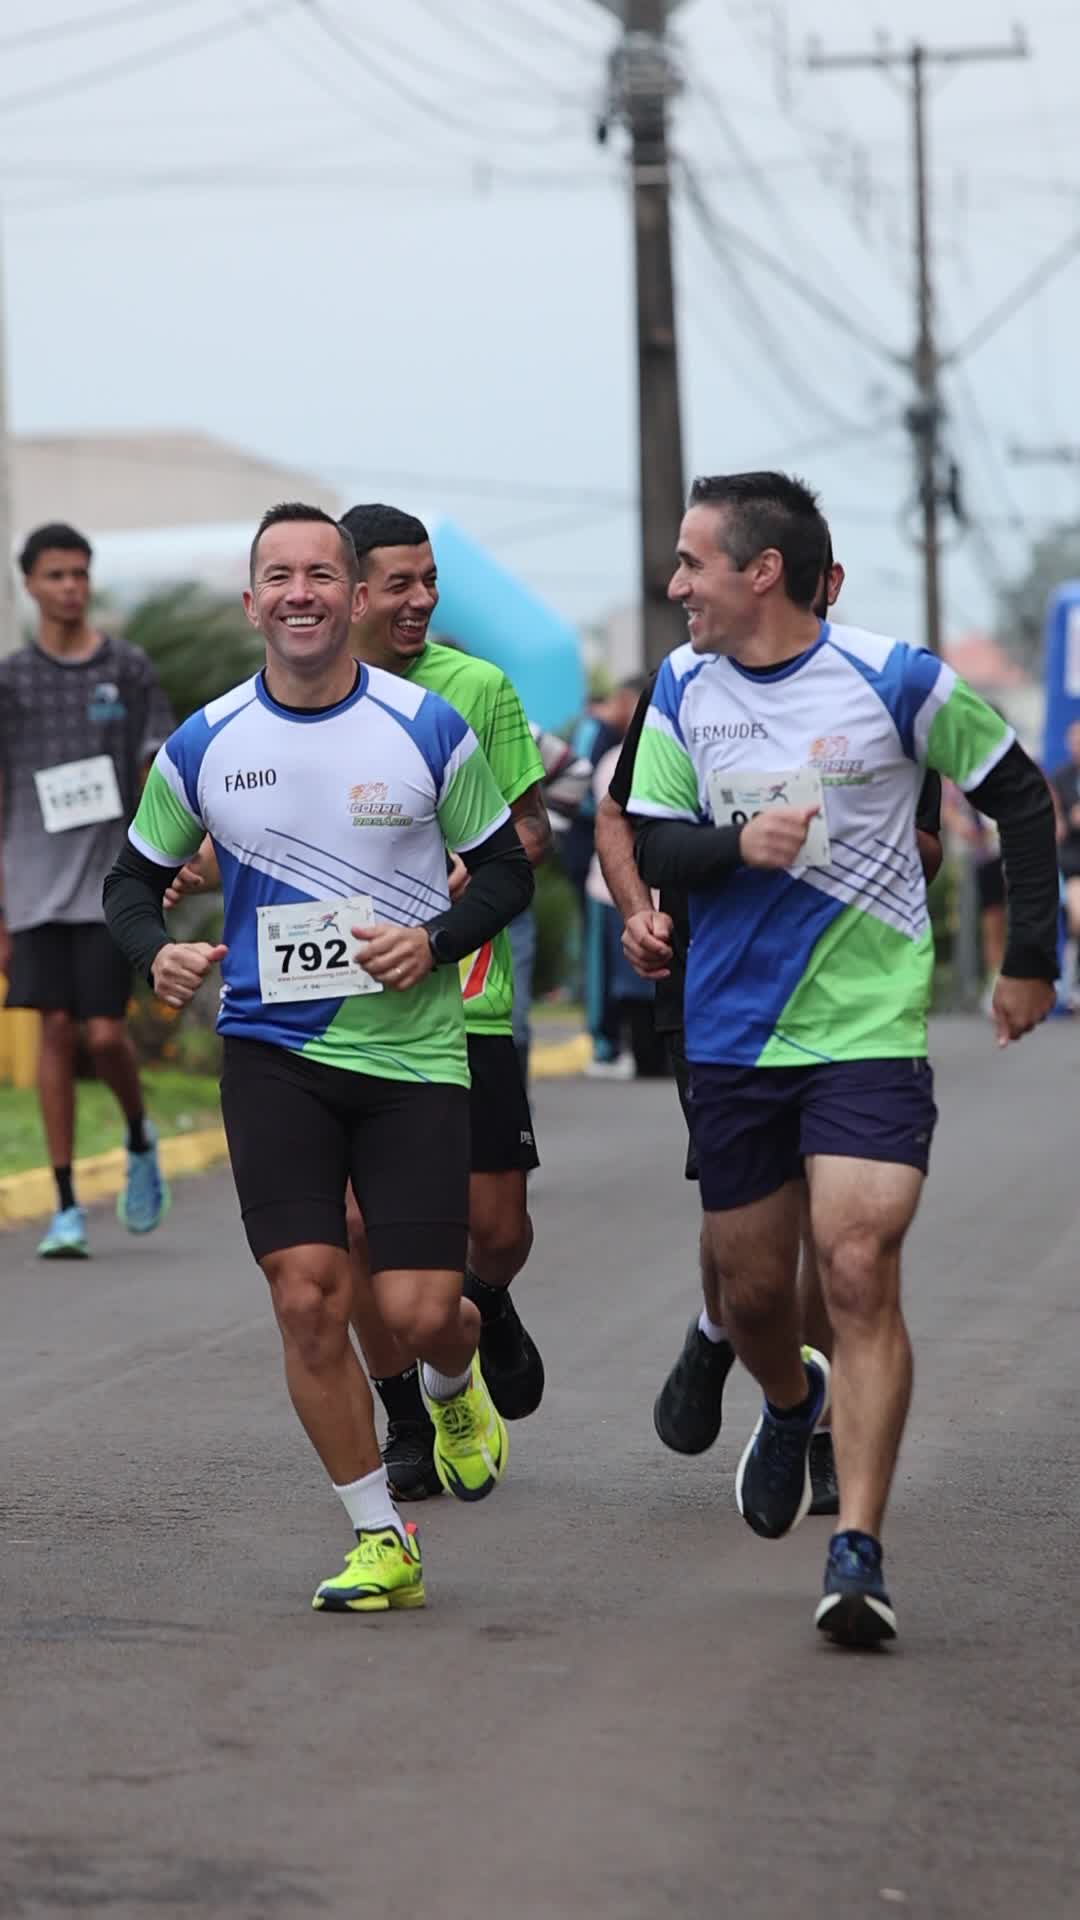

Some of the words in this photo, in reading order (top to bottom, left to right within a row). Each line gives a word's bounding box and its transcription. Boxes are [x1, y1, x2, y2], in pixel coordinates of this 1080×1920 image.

[690, 722, 769, 744] ERMUDES
[225, 768, 277, 792] FÁBIO
[351, 803, 402, 814] CORRE
[275, 939, 349, 974] 792
